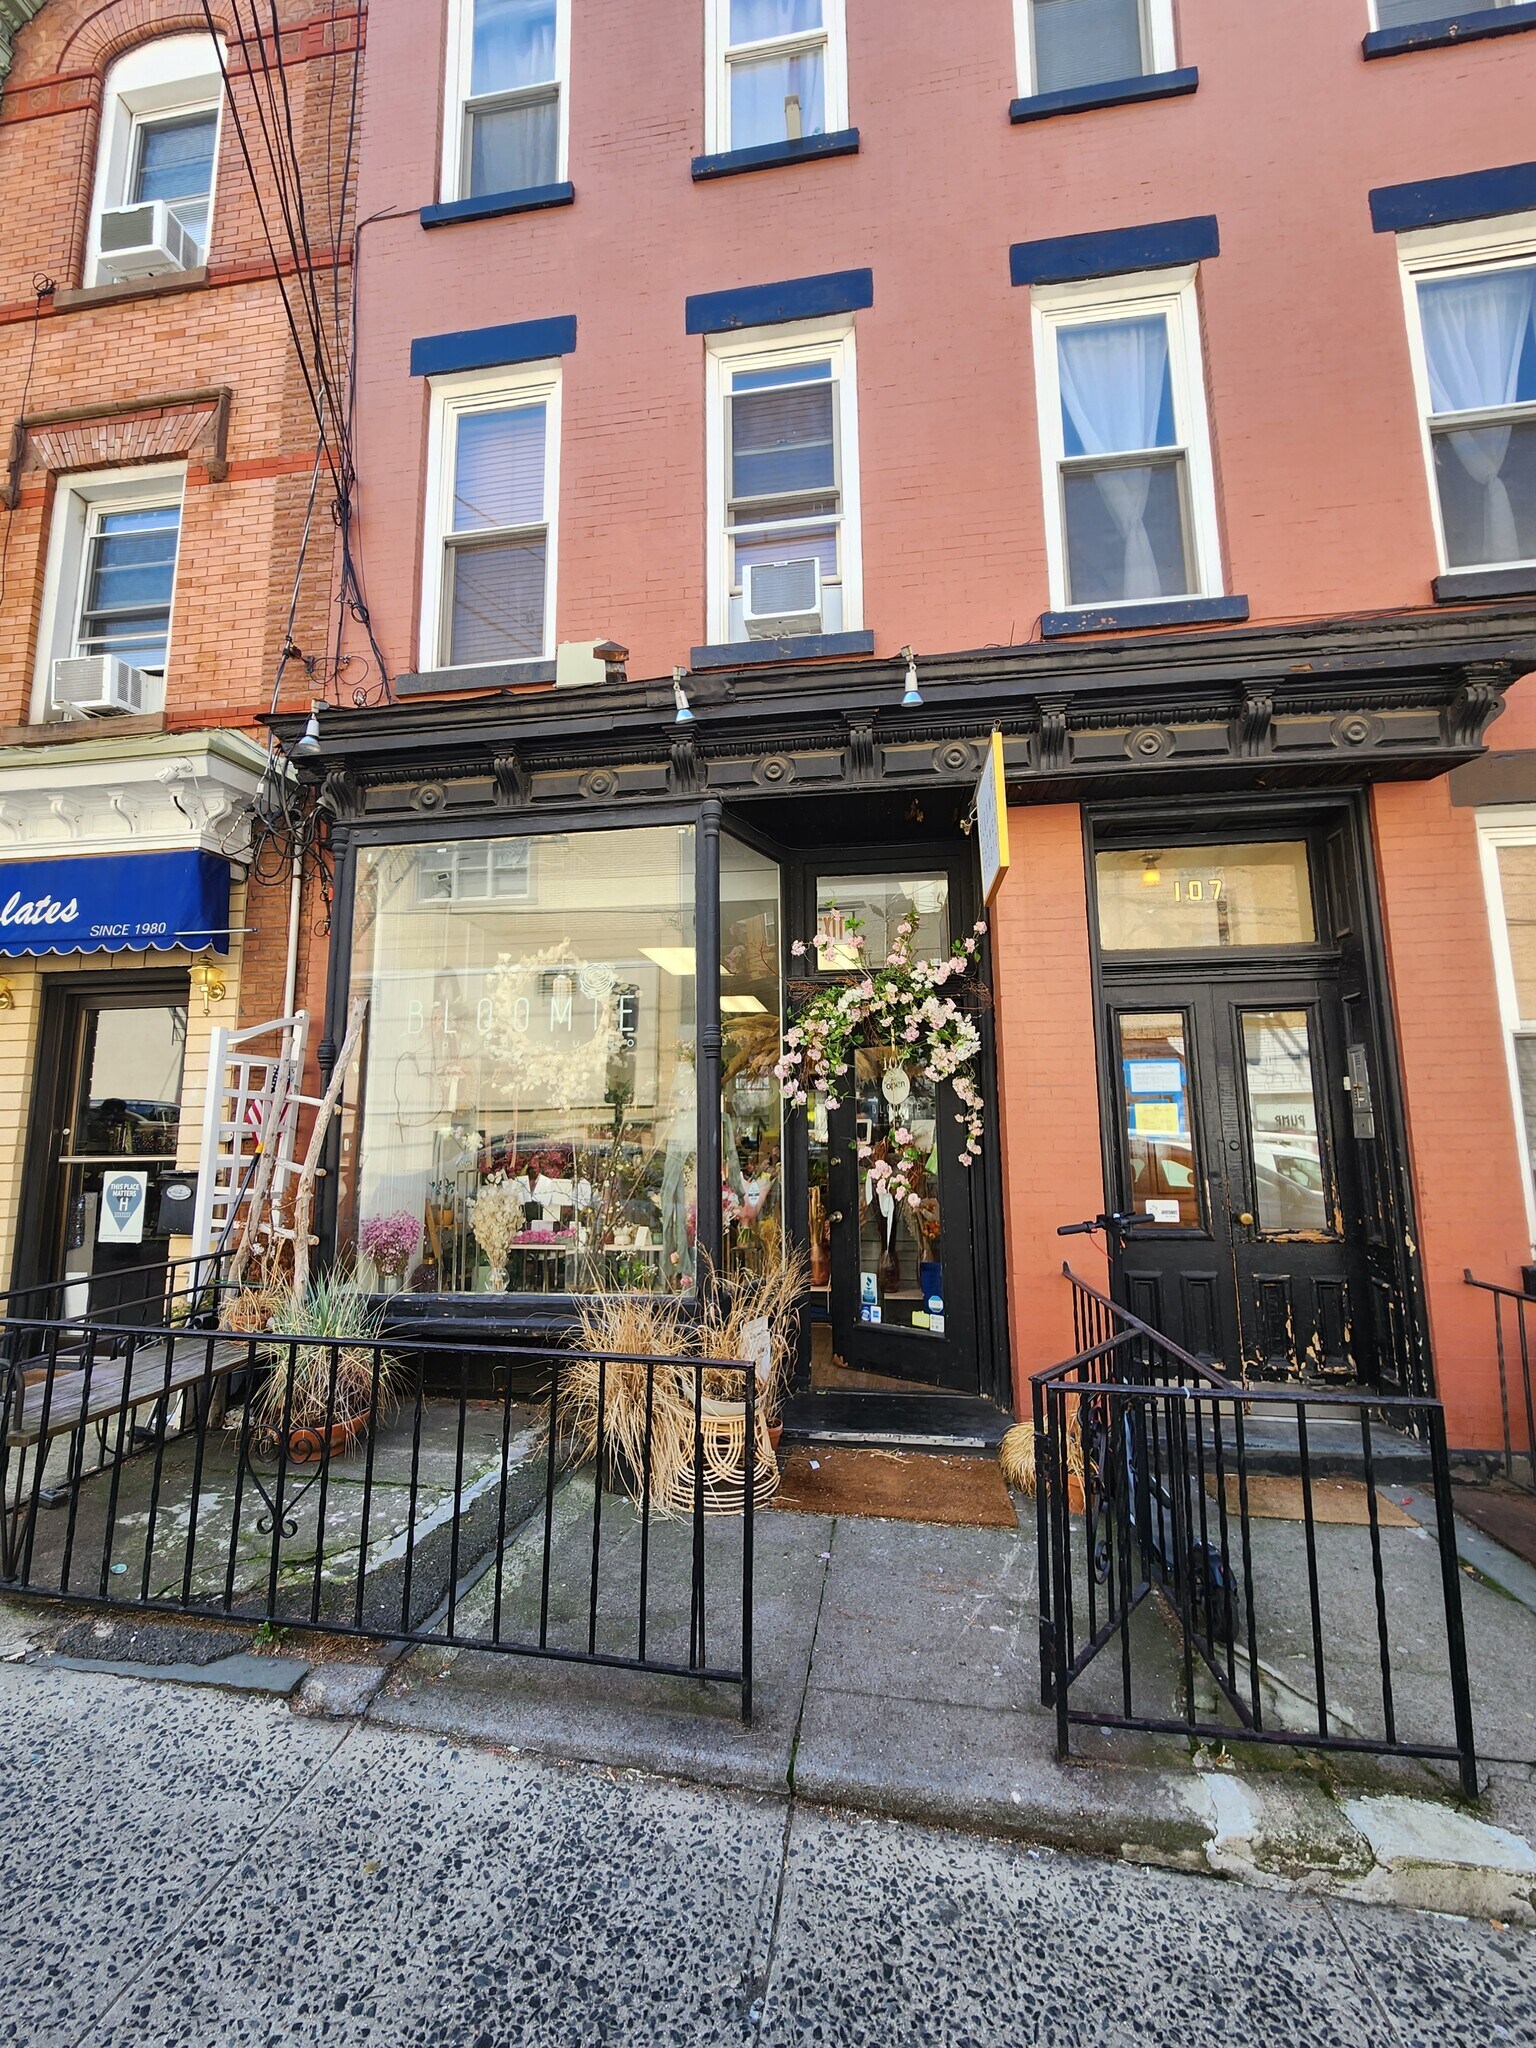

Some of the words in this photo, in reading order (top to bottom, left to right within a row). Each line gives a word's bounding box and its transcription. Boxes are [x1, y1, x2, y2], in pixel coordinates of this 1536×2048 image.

[1174, 879, 1222, 902] 107
[89, 924, 131, 937] SINCE
[134, 922, 167, 935] 1980
[817, 915, 845, 940] XIT
[407, 994, 635, 1034] BLOOMIE
[535, 1038, 635, 1049] STUO
[110, 1183, 124, 1191] THIS
[123, 1183, 140, 1191] PLACE
